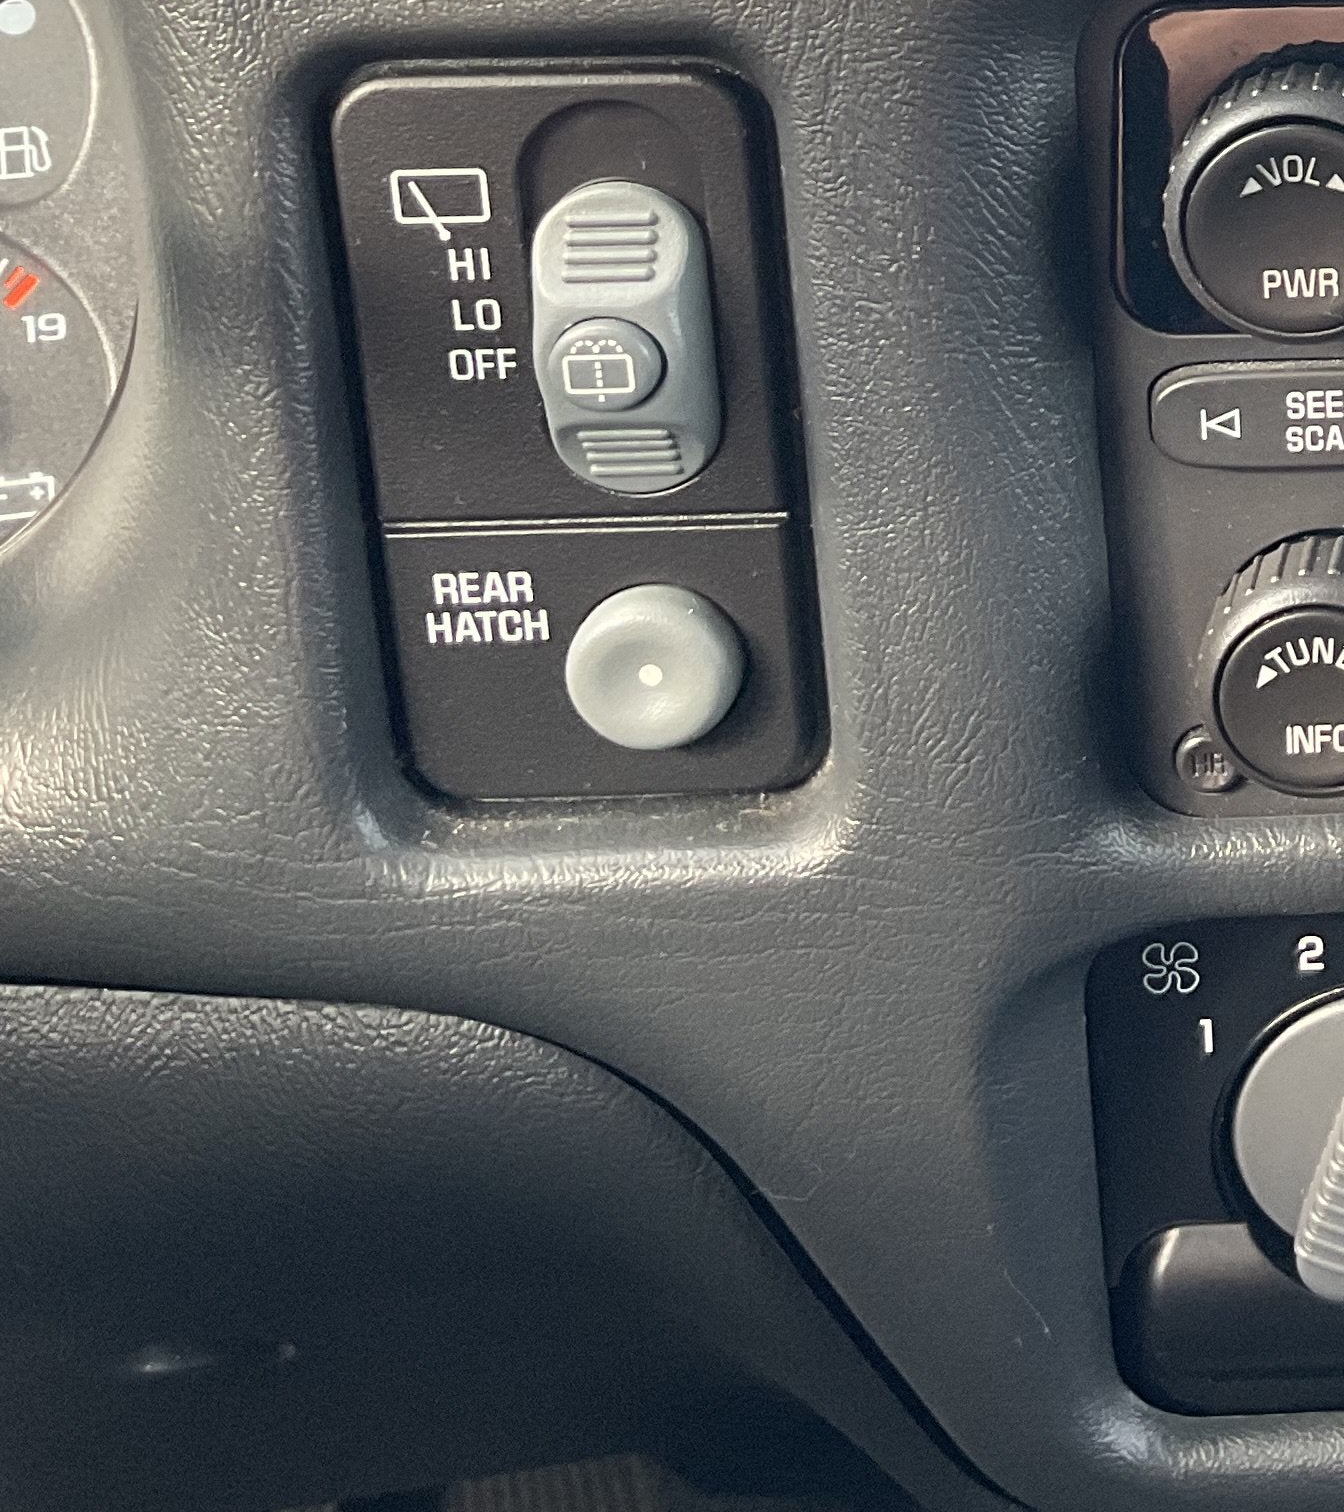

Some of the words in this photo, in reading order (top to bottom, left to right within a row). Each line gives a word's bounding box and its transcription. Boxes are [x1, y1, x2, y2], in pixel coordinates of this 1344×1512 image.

[1256, 155, 1320, 187] VOL
[448, 248, 490, 281] HI
[1263, 268, 1338, 298] PWR
[21, 313, 66, 344] 19
[452, 299, 501, 330] LO
[449, 348, 516, 380] OFF
[432, 571, 533, 605] REAR
[426, 610, 549, 643] HATCH
[1298, 936, 1324, 970] 2
[1200, 1019, 1213, 1053] 1
